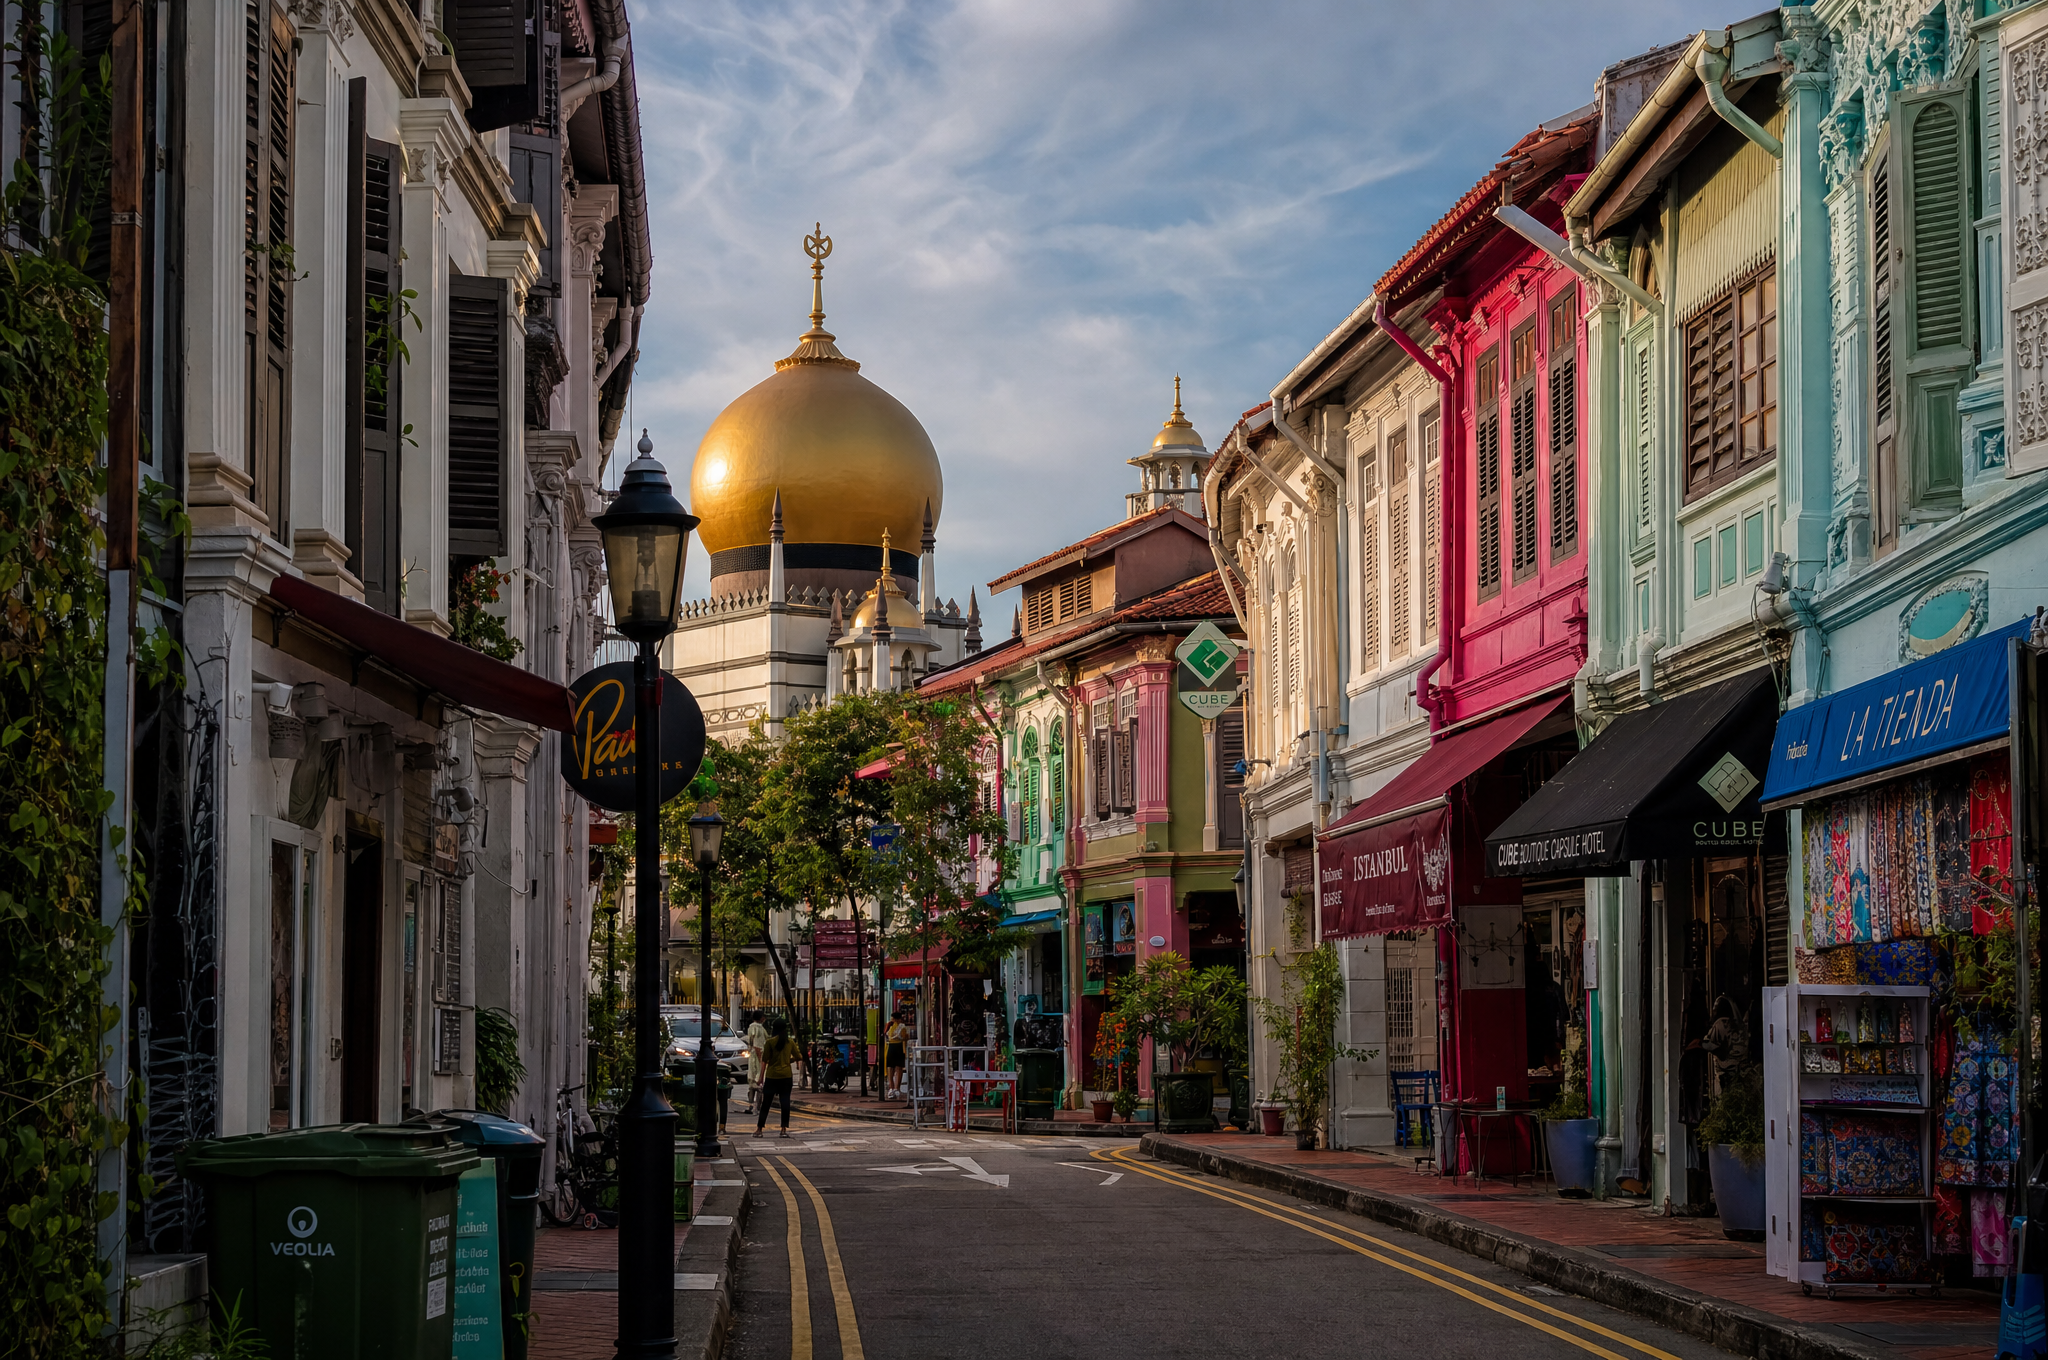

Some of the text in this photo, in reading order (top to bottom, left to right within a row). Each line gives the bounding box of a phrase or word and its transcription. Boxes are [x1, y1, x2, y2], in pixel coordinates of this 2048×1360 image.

[1188, 694, 1230, 705] CUBE
[1840, 673, 1959, 762] LA TIENDA
[1693, 821, 1765, 838] CUBE
[1498, 831, 1606, 867] CUBE BOUTIQUE CAPSULE HOTEL
[1353, 845, 1409, 882] ISTANBUL
[269, 1241, 336, 1257] VEOLIA
